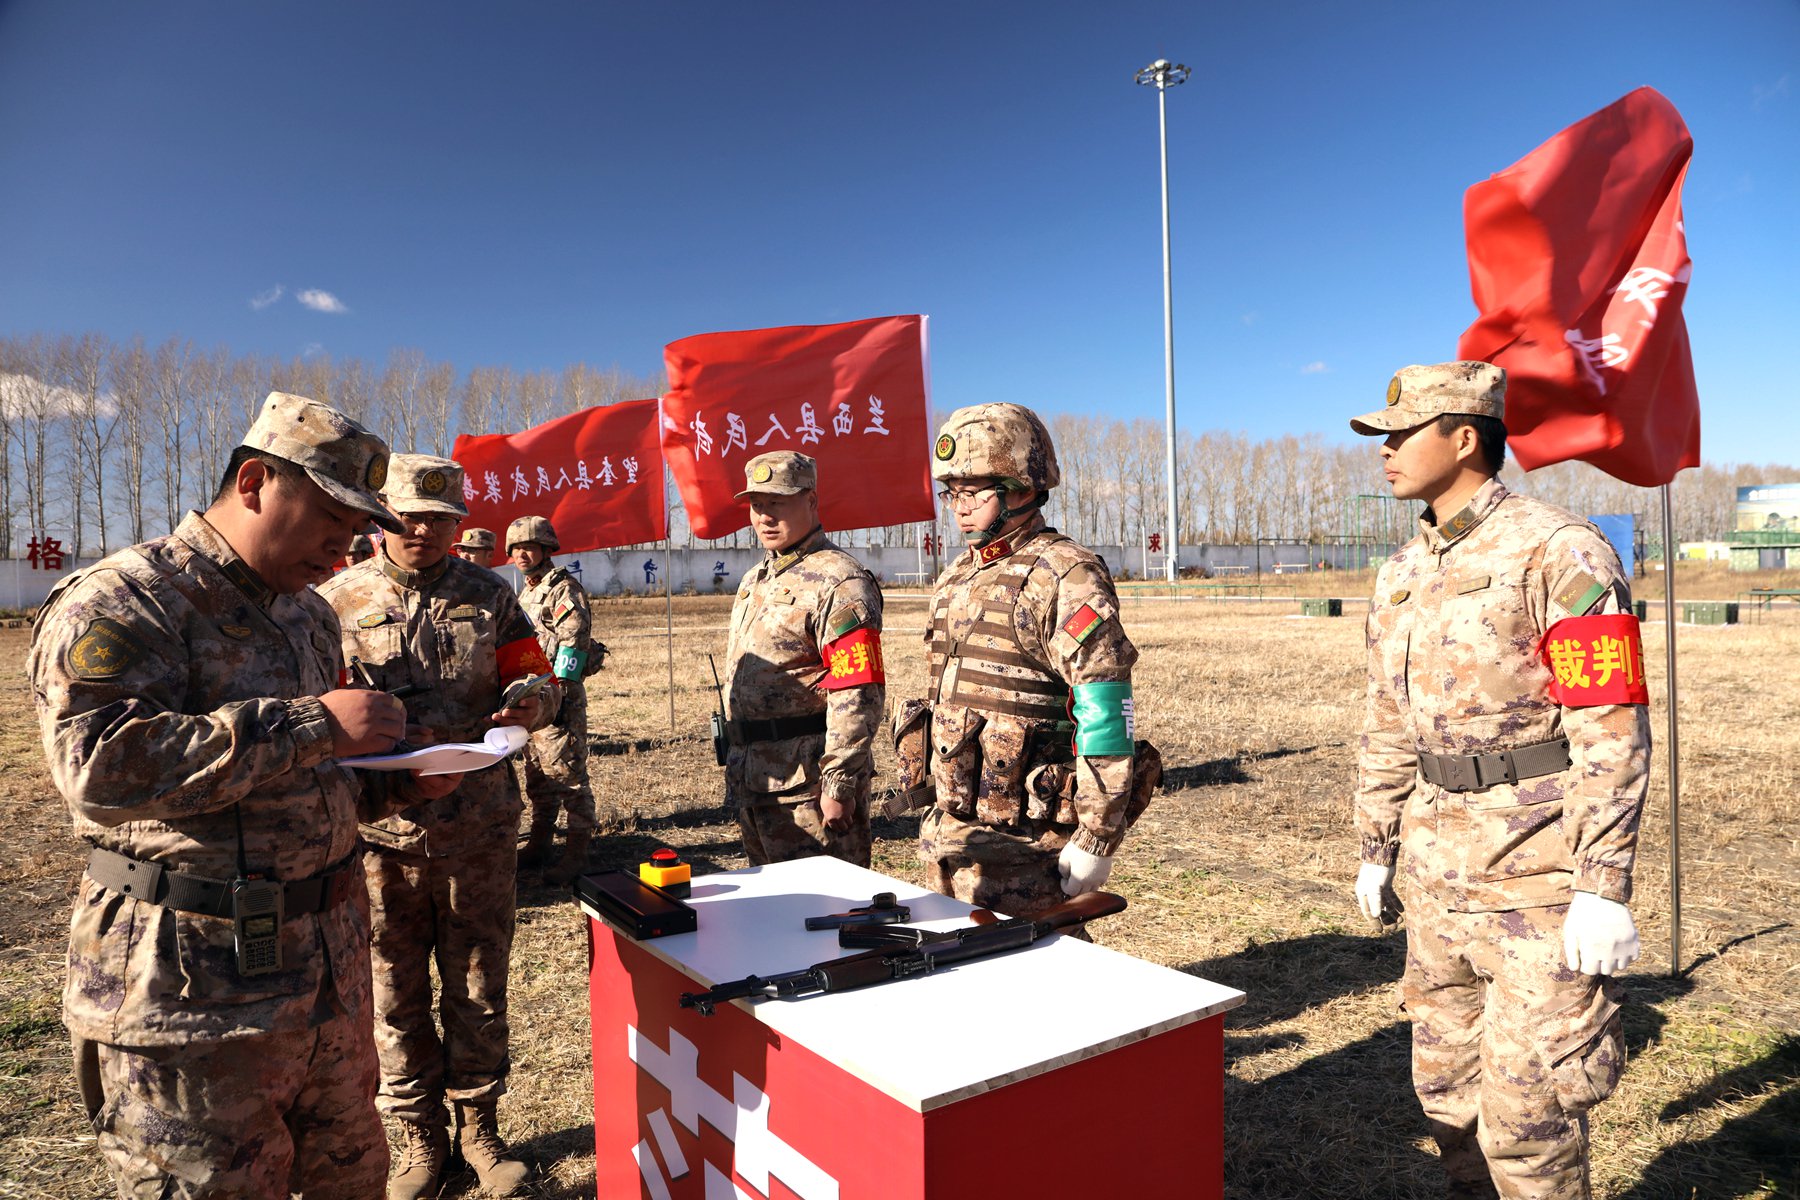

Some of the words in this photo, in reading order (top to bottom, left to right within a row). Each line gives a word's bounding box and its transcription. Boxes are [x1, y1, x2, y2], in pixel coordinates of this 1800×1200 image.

[26, 536, 66, 571] 格
[1148, 532, 1161, 553] 求
[1549, 635, 1645, 689] 裁判
